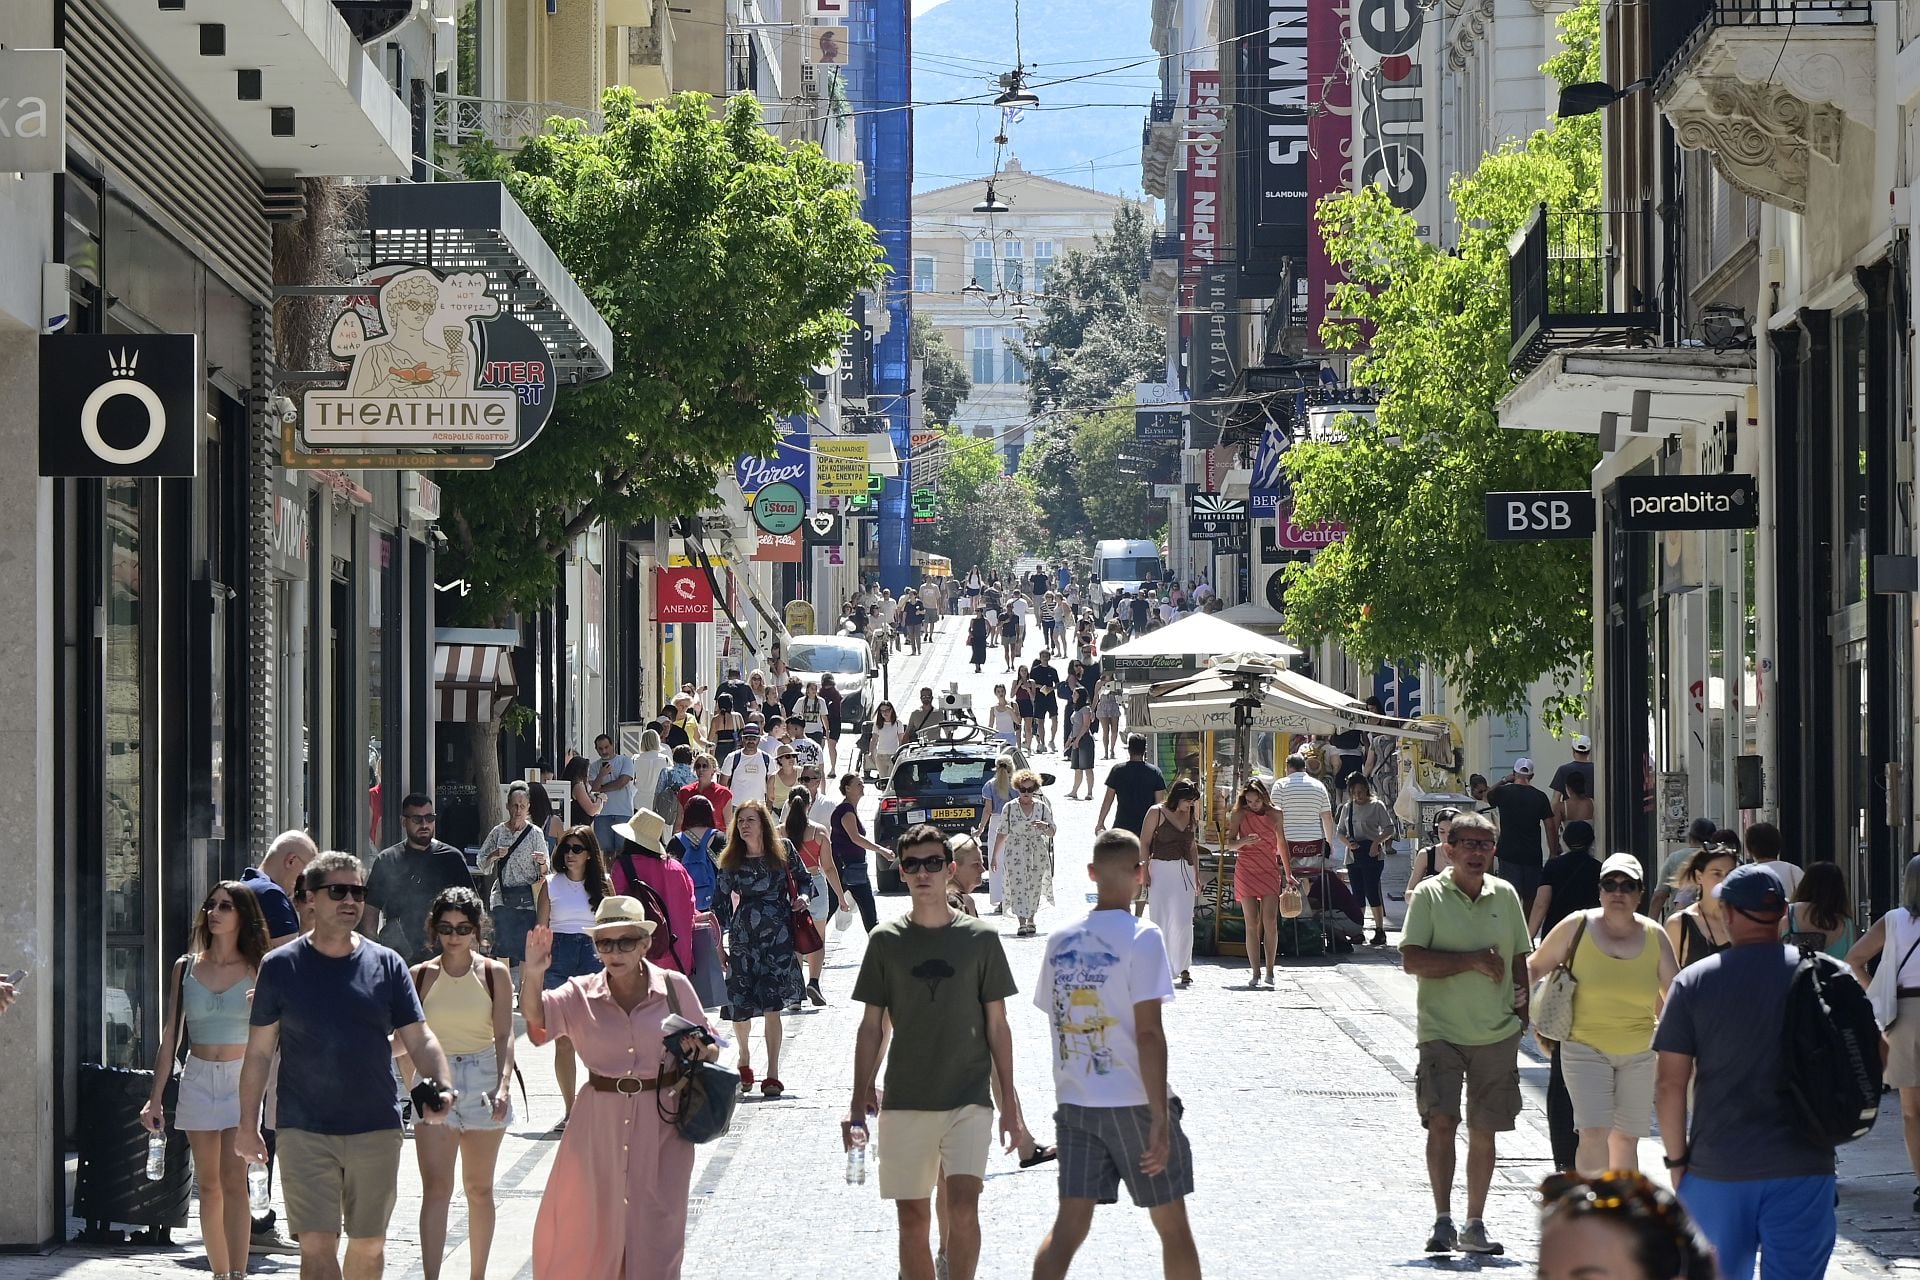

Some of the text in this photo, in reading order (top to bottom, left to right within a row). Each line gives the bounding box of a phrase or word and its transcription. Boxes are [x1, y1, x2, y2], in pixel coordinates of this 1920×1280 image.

[482, 361, 545, 383] NTER
[433, 432, 509, 440] ACROPOLIS ROOFTOP
[398, 457, 435, 465] FLOOR
[741, 455, 805, 488] Parex
[765, 503, 795, 513] iStoa
[1630, 492, 1730, 517] parabita
[1507, 501, 1572, 530] BSB
[1286, 524, 1348, 543] Center
[663, 604, 709, 613] ΑΝΕΜΟΣ
[1152, 655, 1183, 667] Flower
